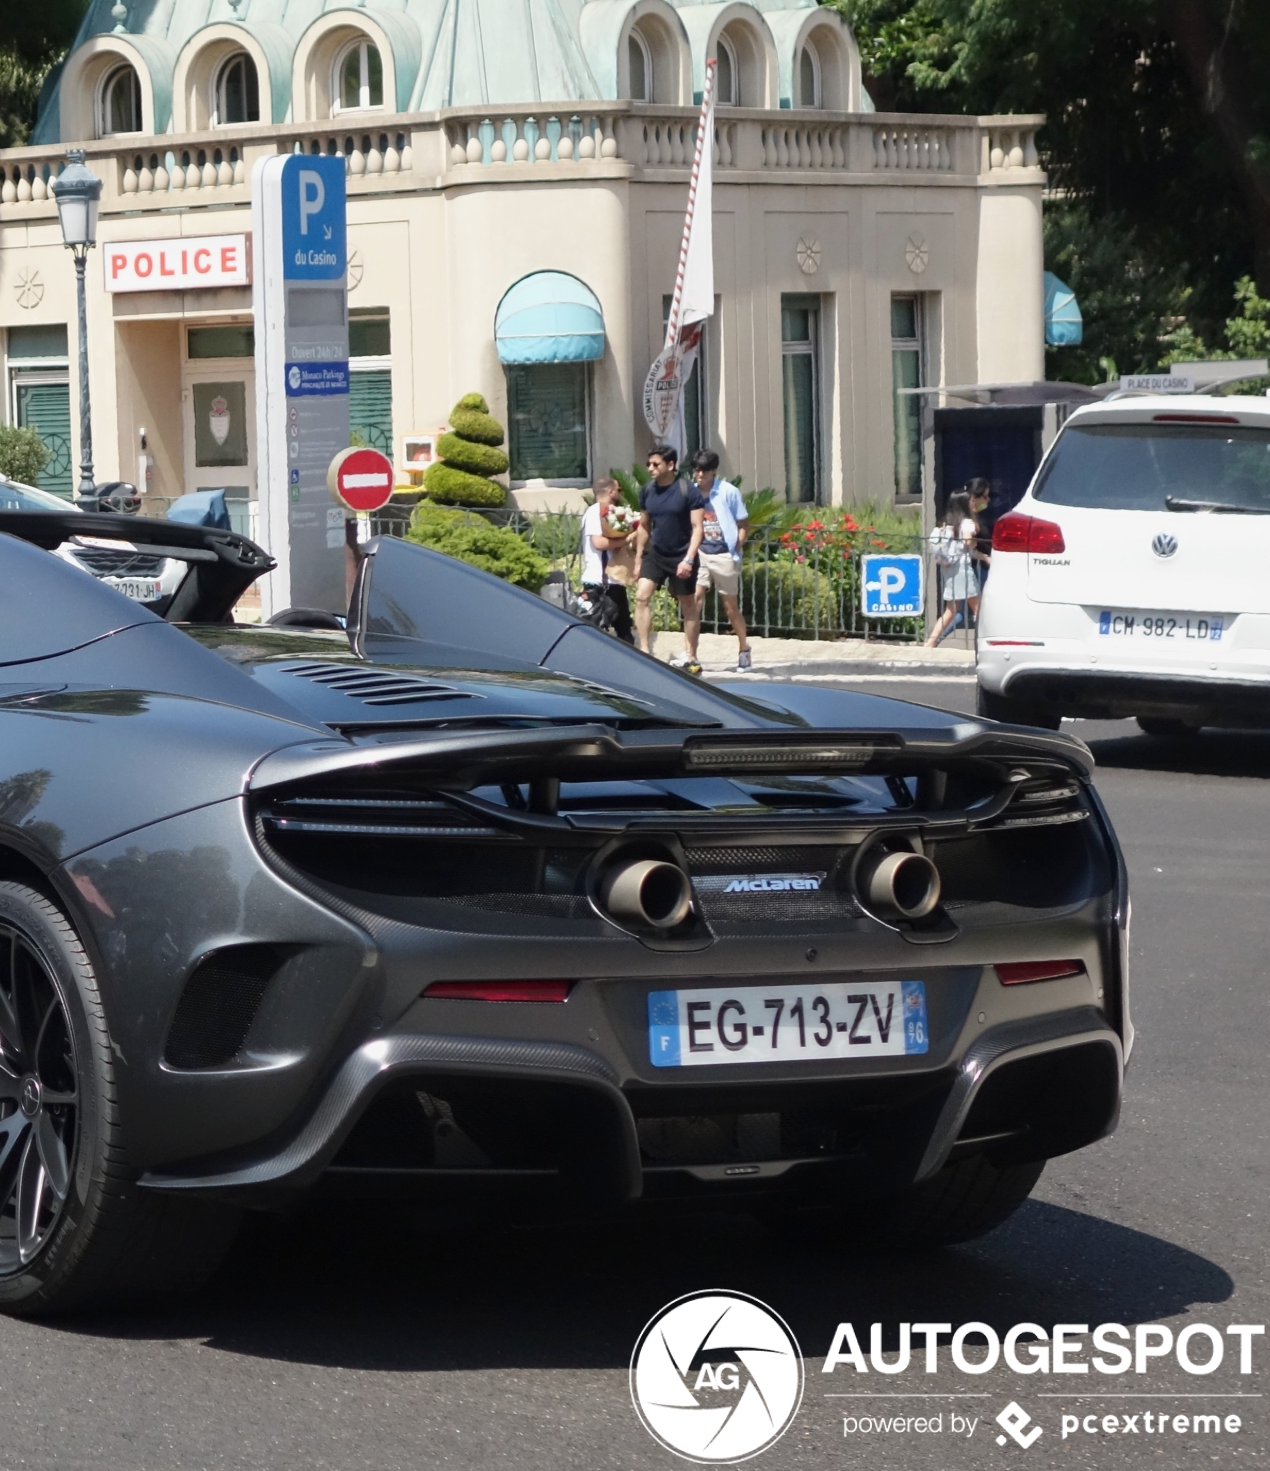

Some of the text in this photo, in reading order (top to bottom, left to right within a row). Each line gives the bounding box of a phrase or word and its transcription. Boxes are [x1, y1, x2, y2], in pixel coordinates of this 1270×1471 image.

[299, 169, 326, 235] P
[111, 246, 238, 279] POLICE
[295, 249, 337, 266] du Casino
[291, 346, 315, 359] Ouvert
[644, 359, 663, 423] COMMISSARIAT
[1127, 377, 1189, 390] PLACE DU CASINO
[1033, 558, 1071, 566] TIGUAN
[878, 566, 907, 604] P
[871, 602, 914, 612] CASINO
[723, 878, 820, 893] McLaren
[660, 1035, 671, 1052] F
[686, 992, 896, 1053] EG-713-ZV
